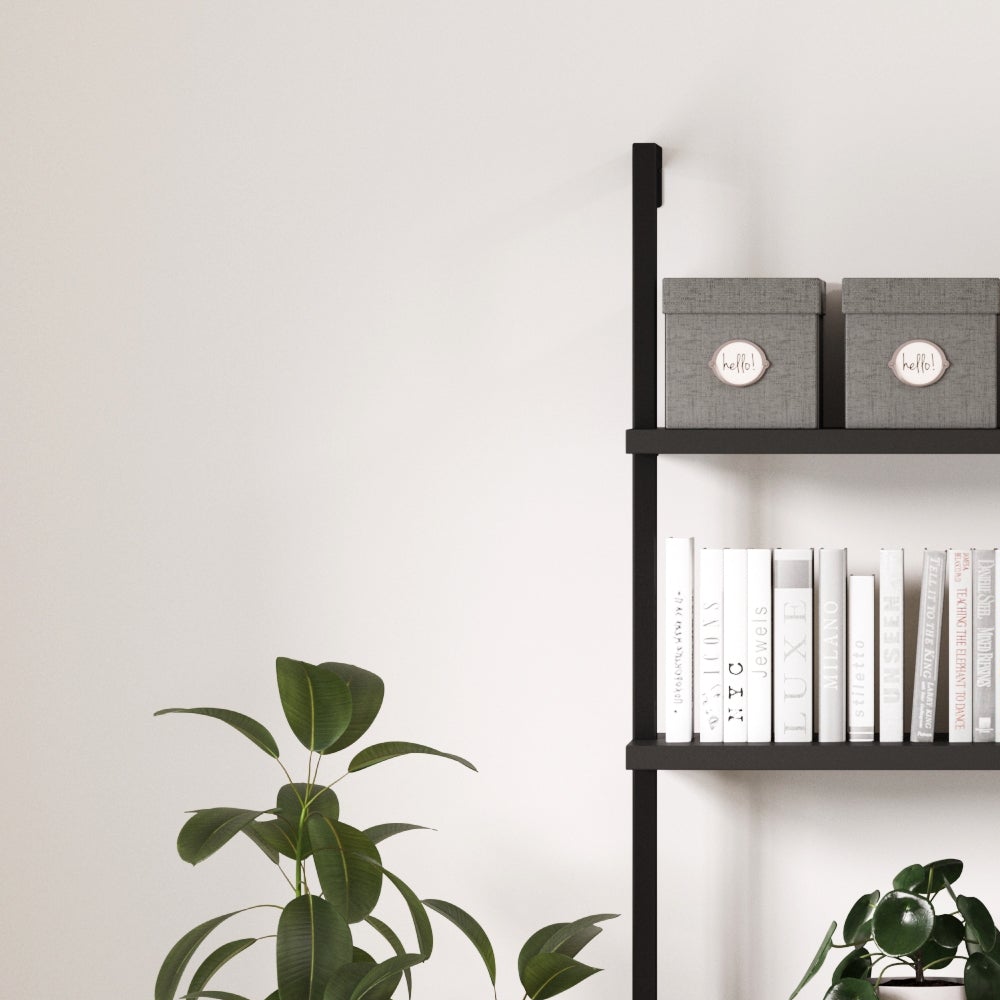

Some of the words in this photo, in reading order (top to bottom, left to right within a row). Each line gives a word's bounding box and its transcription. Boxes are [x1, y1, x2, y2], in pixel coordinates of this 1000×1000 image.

[722, 352, 756, 374] hello!
[902, 352, 936, 374] hello!
[928, 557, 941, 586] TELL
[979, 559, 994, 593] DANIELLE
[926, 606, 936, 620] TO
[956, 588, 967, 627] TEACHING
[752, 606, 768, 678] Jewels
[823, 601, 838, 690] MILANO
[924, 622, 935, 646] THE
[956, 629, 966, 646] THE
[784, 600, 807, 735] LUXE
[923, 648, 935, 679] KING
[955, 648, 966, 688] ELEPHANT
[728, 662, 744, 722] NYC
[851, 640, 865, 718] stiletto
[955, 691, 965, 701] TO
[924, 708, 933, 729] KING
[955, 703, 965, 730] DANCE
